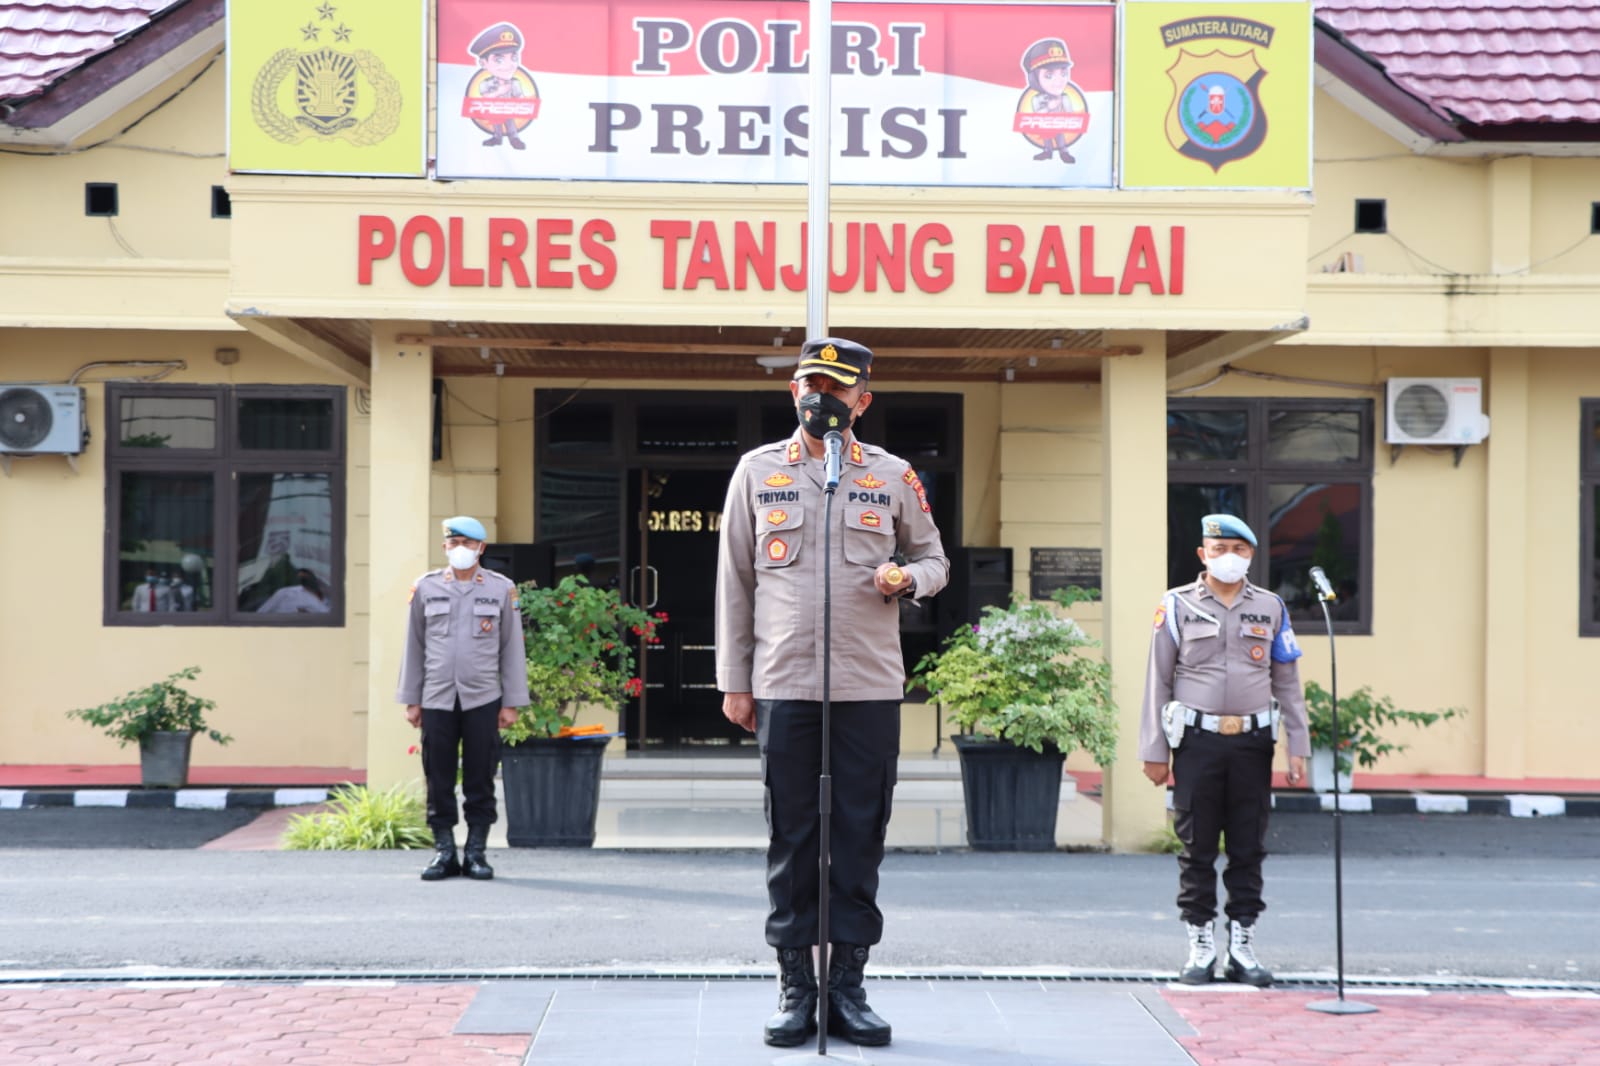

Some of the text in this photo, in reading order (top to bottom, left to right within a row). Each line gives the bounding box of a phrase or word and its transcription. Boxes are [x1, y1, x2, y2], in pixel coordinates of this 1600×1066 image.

[1165, 20, 1270, 44] SUMATERA UTARA
[634, 19, 924, 77] POLRI
[469, 100, 535, 115] PRESISI
[588, 102, 967, 160] PRESISI
[1019, 115, 1084, 129] PRESISI
[357, 214, 1185, 296] POLRES TANJUNG BALAI
[757, 490, 799, 506] TRIYADI
[848, 491, 892, 507] POLRI
[639, 510, 703, 532] OLRES
[1240, 613, 1272, 625] POLRI
